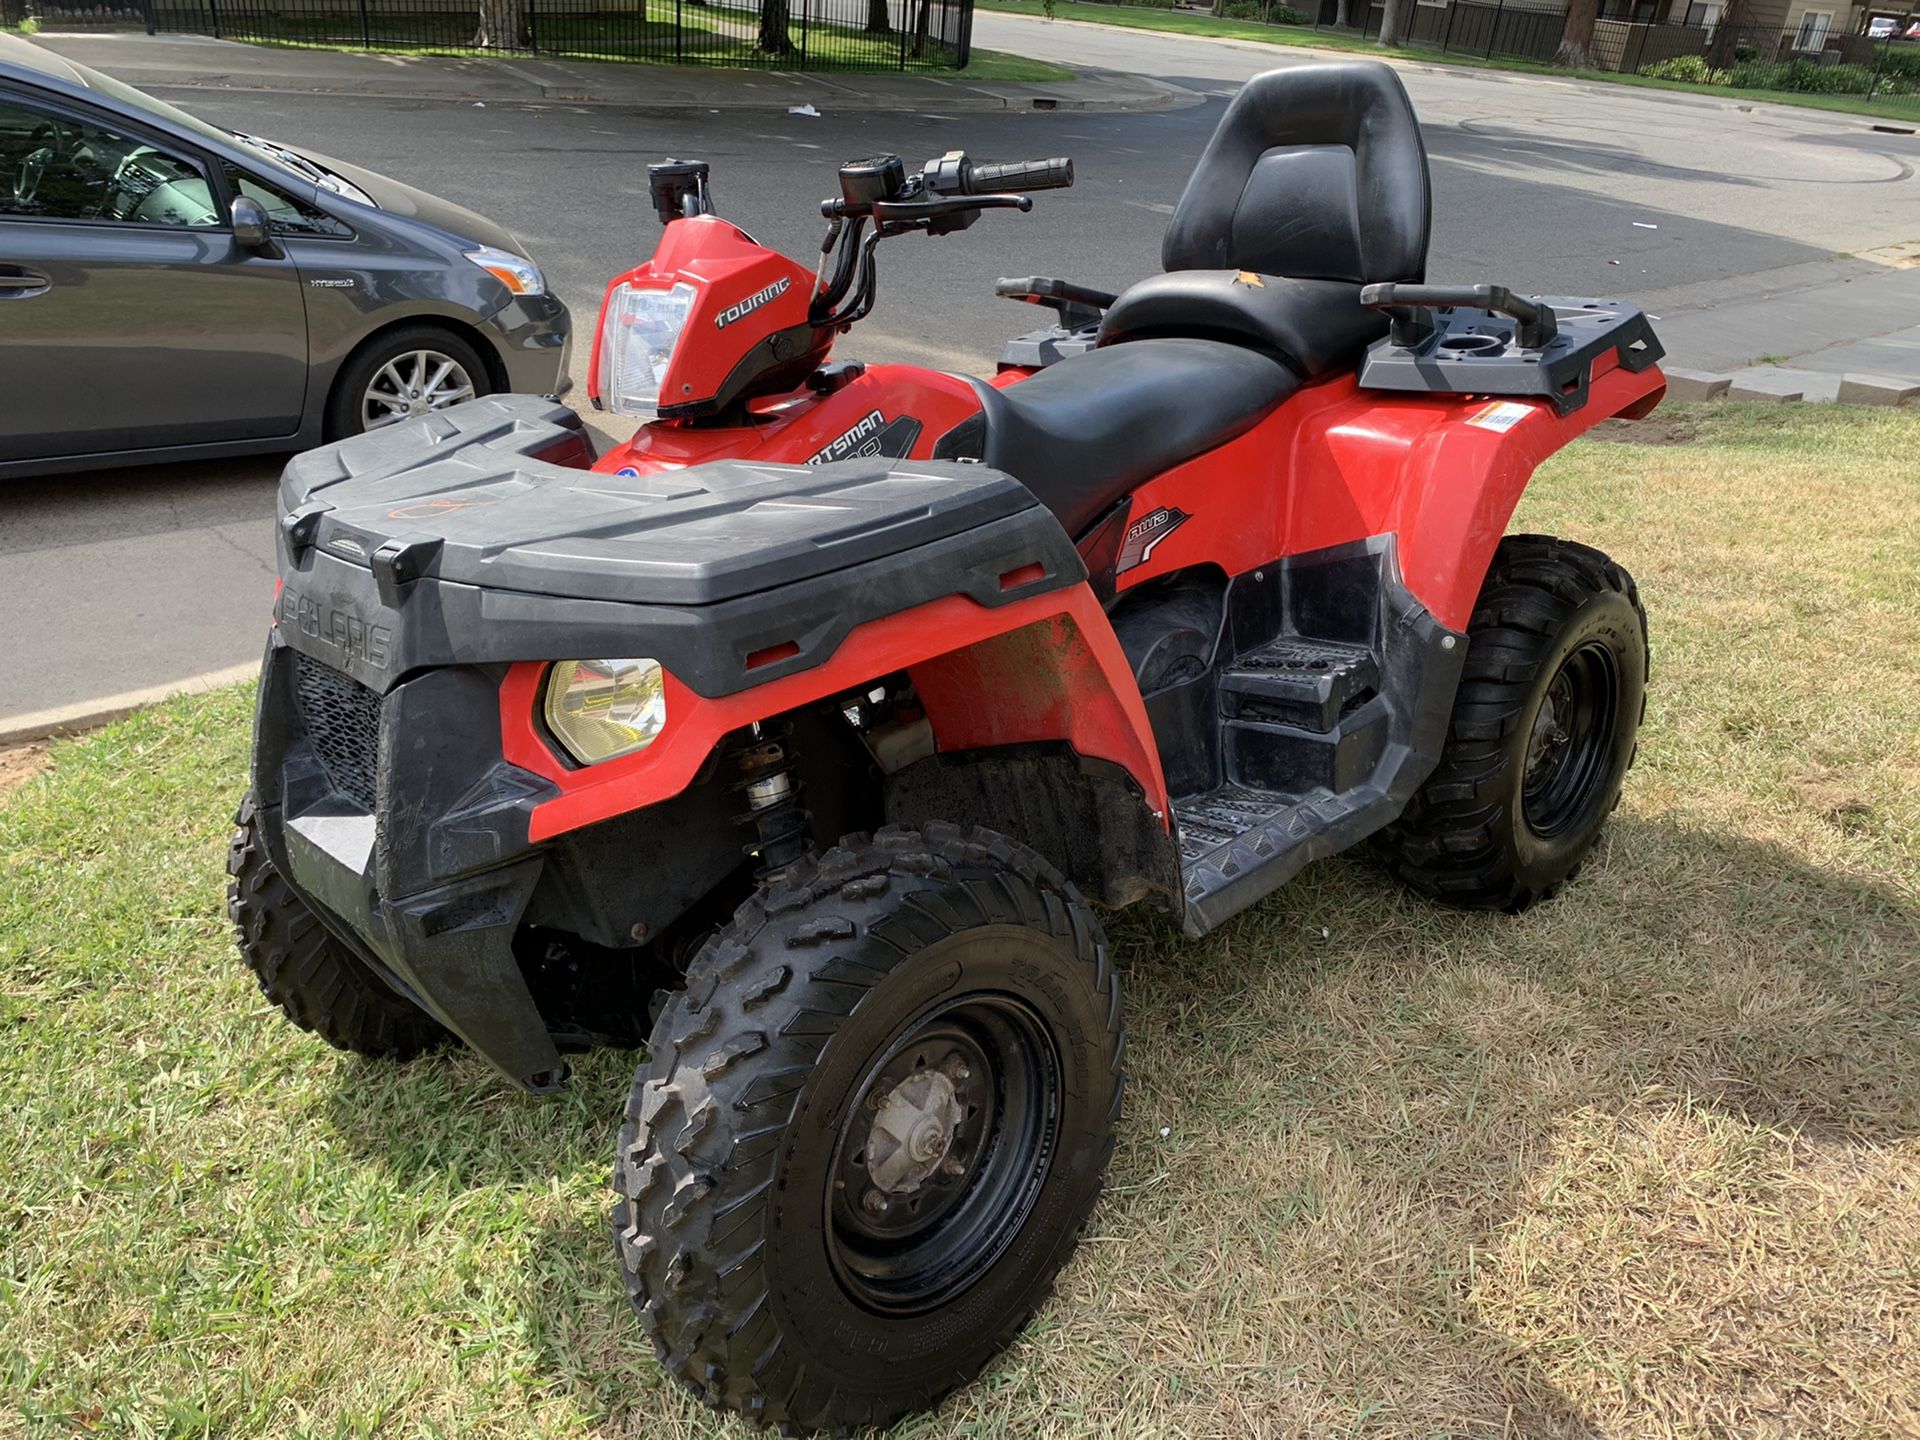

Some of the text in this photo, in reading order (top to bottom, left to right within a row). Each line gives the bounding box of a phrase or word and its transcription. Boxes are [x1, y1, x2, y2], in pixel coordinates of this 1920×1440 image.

[714, 276, 791, 328] TOURING
[803, 409, 884, 465] RTSMAN
[1128, 510, 1169, 541] AWD
[280, 585, 393, 671] POLARIS
